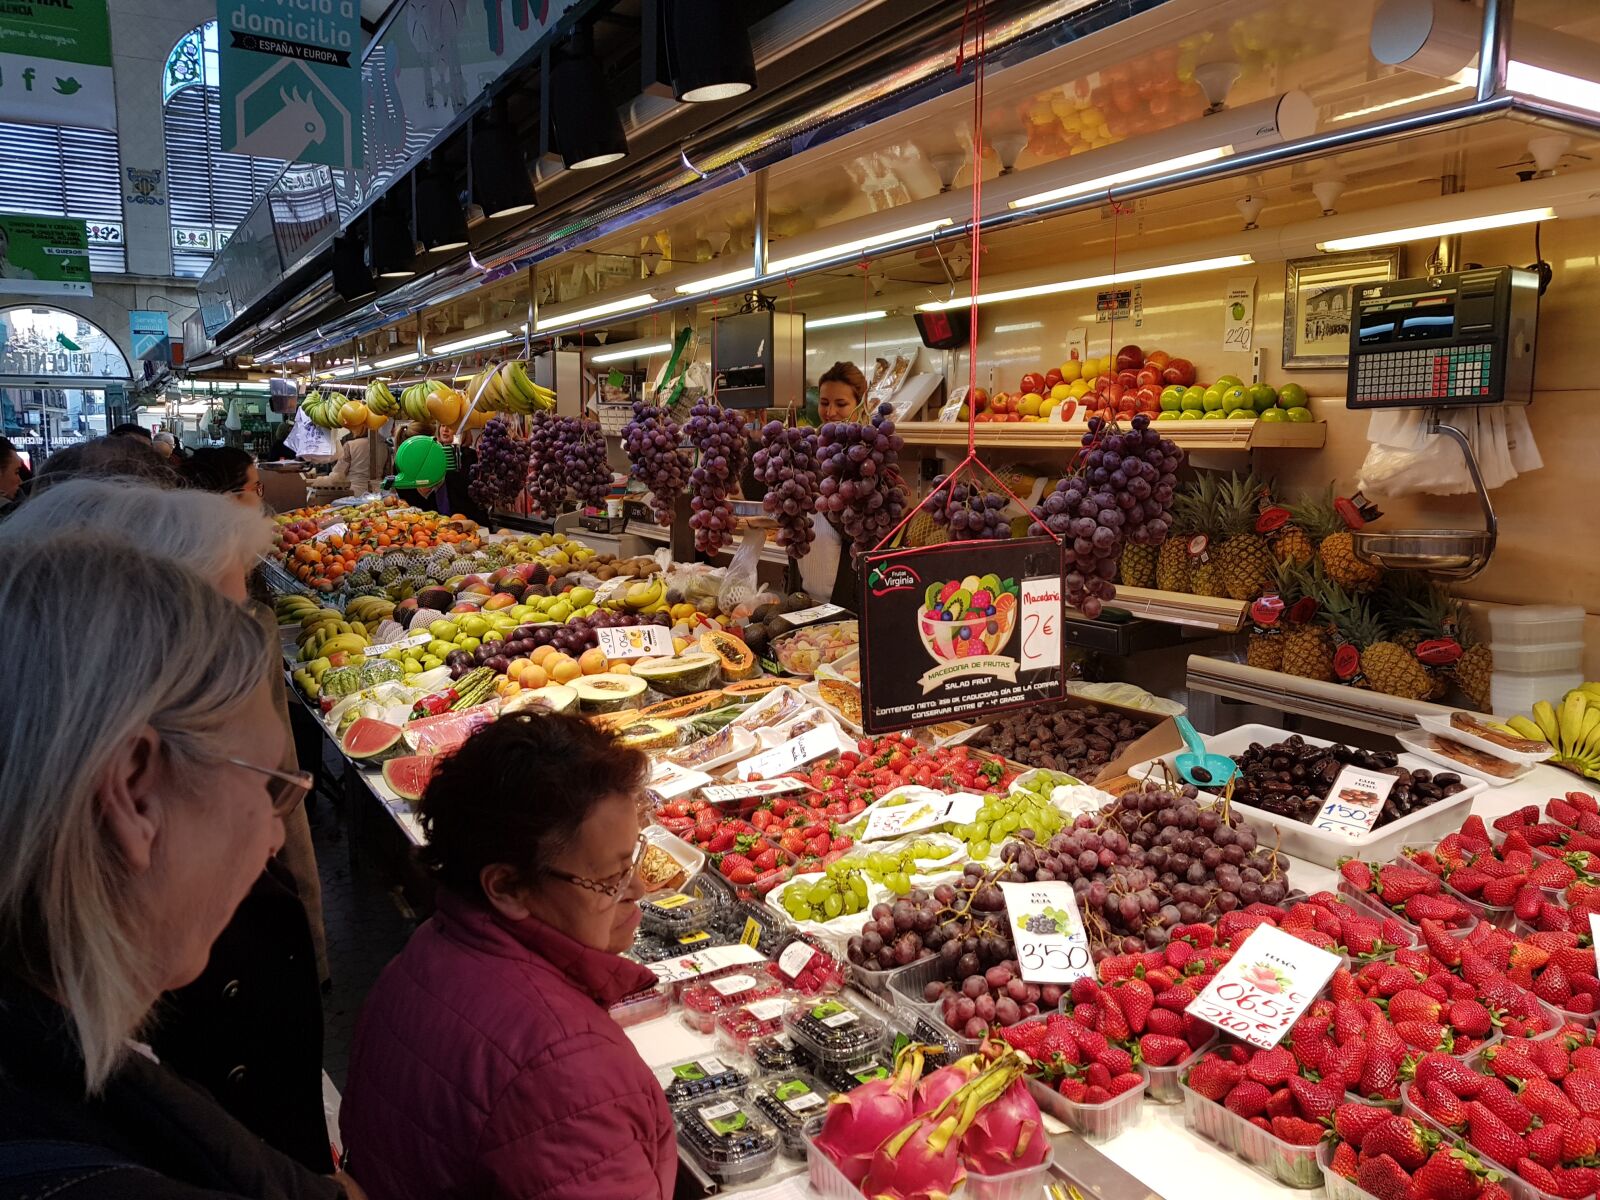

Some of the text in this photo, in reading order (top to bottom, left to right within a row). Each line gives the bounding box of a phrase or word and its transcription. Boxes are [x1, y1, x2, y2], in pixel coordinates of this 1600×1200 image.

[340, 1, 353, 18] a
[231, 4, 352, 47] domicilio
[259, 40, 338, 63] ESPAÑA Y EUROPA
[1225, 326, 1250, 345] 2'20
[884, 576, 914, 587] Virginia
[1023, 614, 1054, 659] 2 €
[928, 663, 969, 680] MACEDONIA
[944, 677, 992, 691] SALAD FRUIT
[875, 704, 915, 716] CONTENIDO
[1033, 680, 1060, 690] COMPRA
[911, 708, 952, 720] CONSERVAR
[953, 703, 976, 712] ENTRE
[999, 694, 1025, 703] GRADOS
[1324, 804, 1367, 820] 1'50
[1021, 943, 1089, 970] 3'50
[1216, 983, 1285, 1018] 0'65
[1198, 1007, 1277, 1033] 2'60 €
